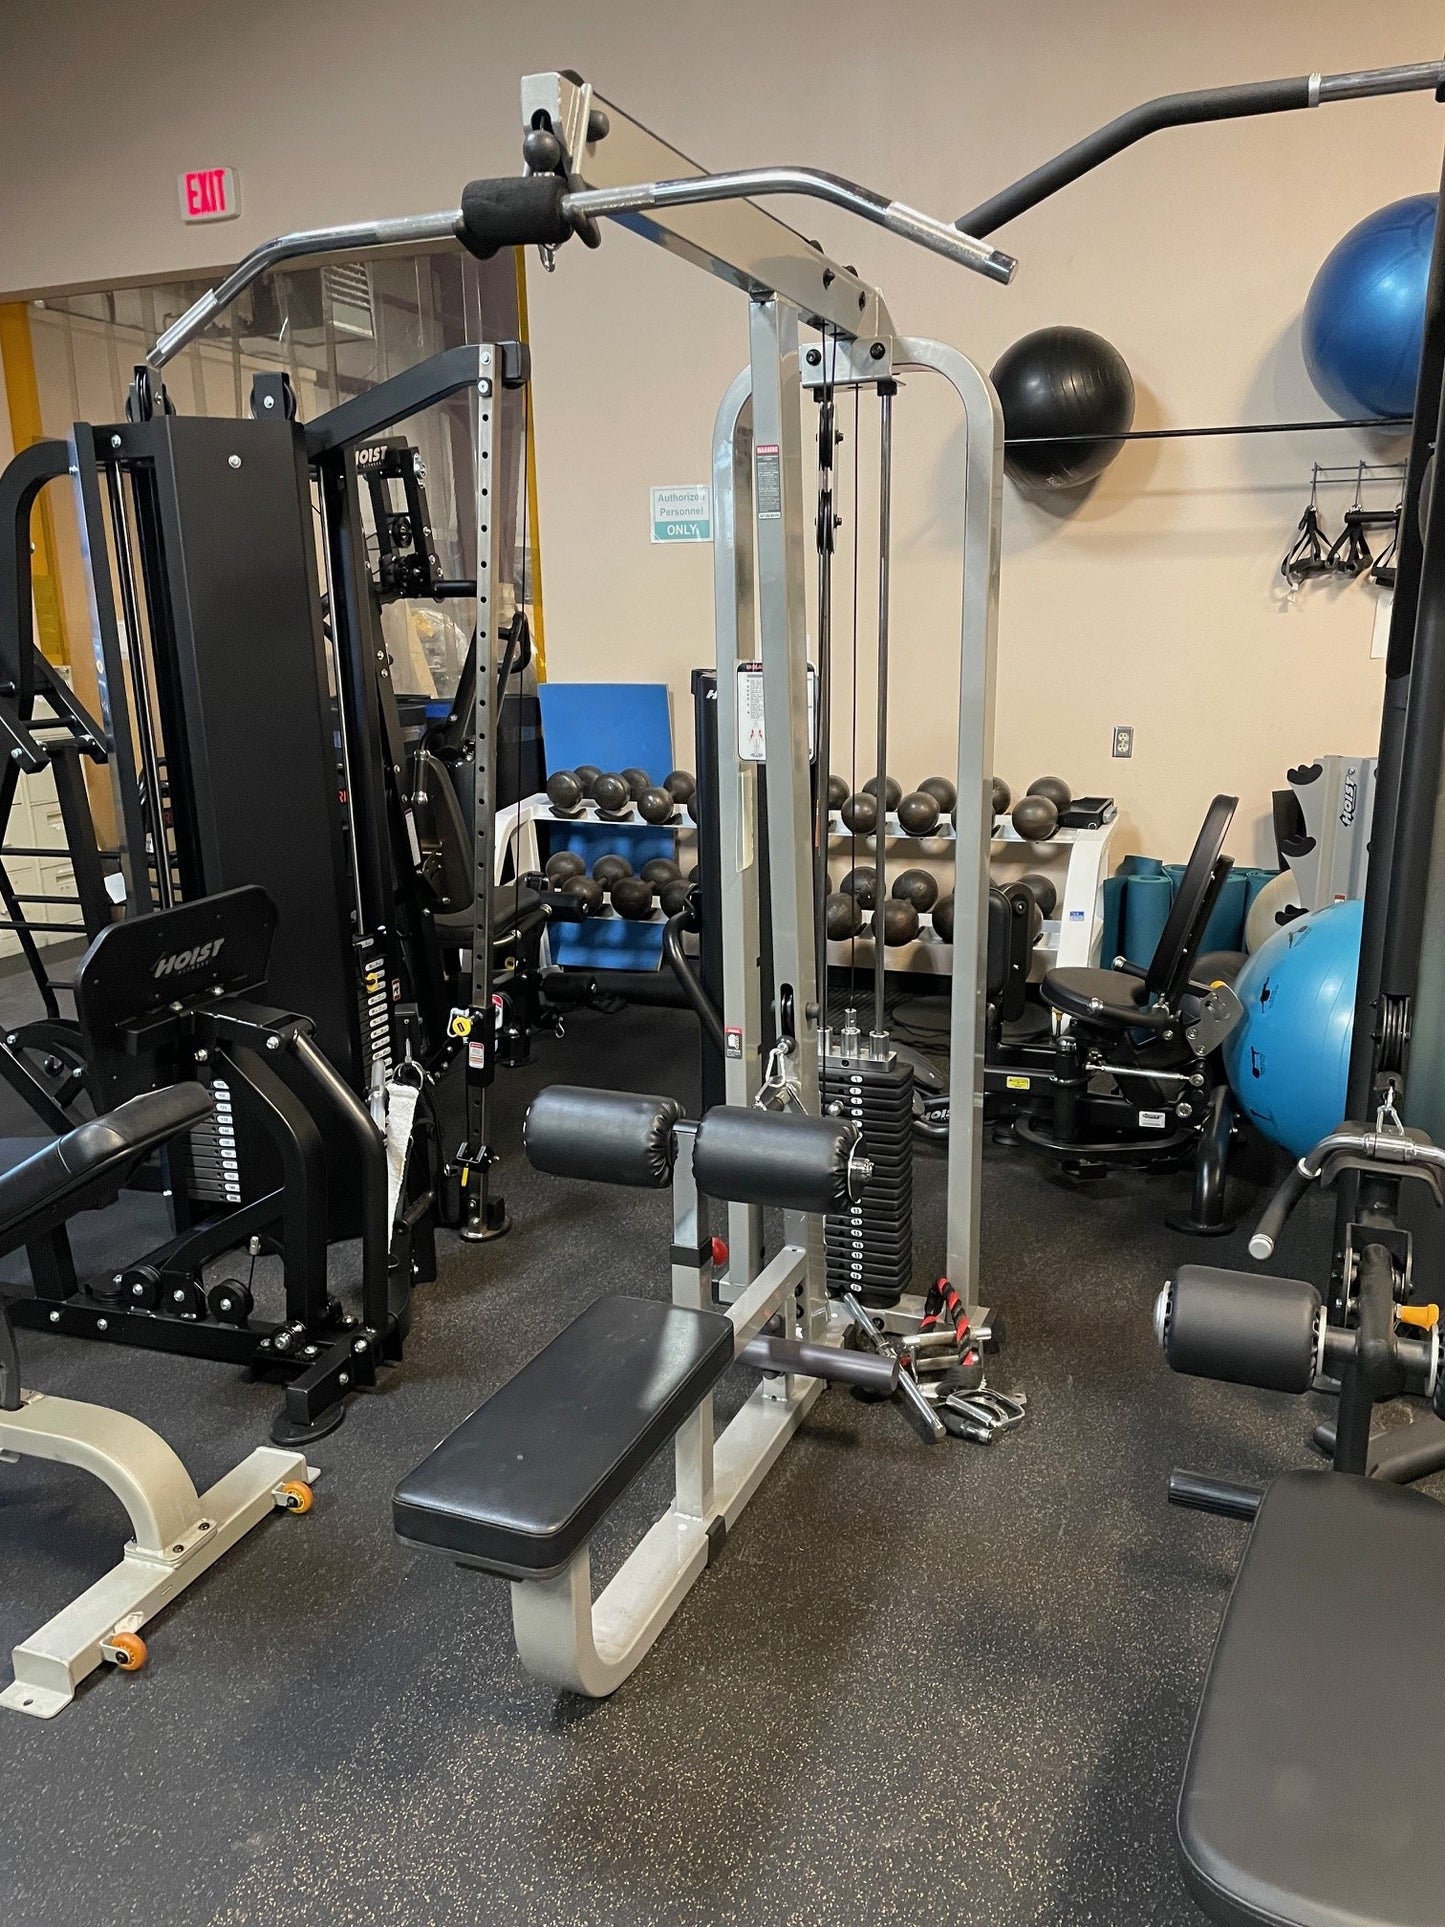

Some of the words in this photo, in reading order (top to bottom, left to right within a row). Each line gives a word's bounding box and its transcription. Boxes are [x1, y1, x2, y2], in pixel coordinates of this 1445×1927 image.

[186, 169, 225, 215] EXIT
[660, 506, 704, 516] Personnel
[666, 523, 698, 536] ONLY
[1340, 774, 1357, 826] HOIST
[154, 938, 225, 978] HOIST
